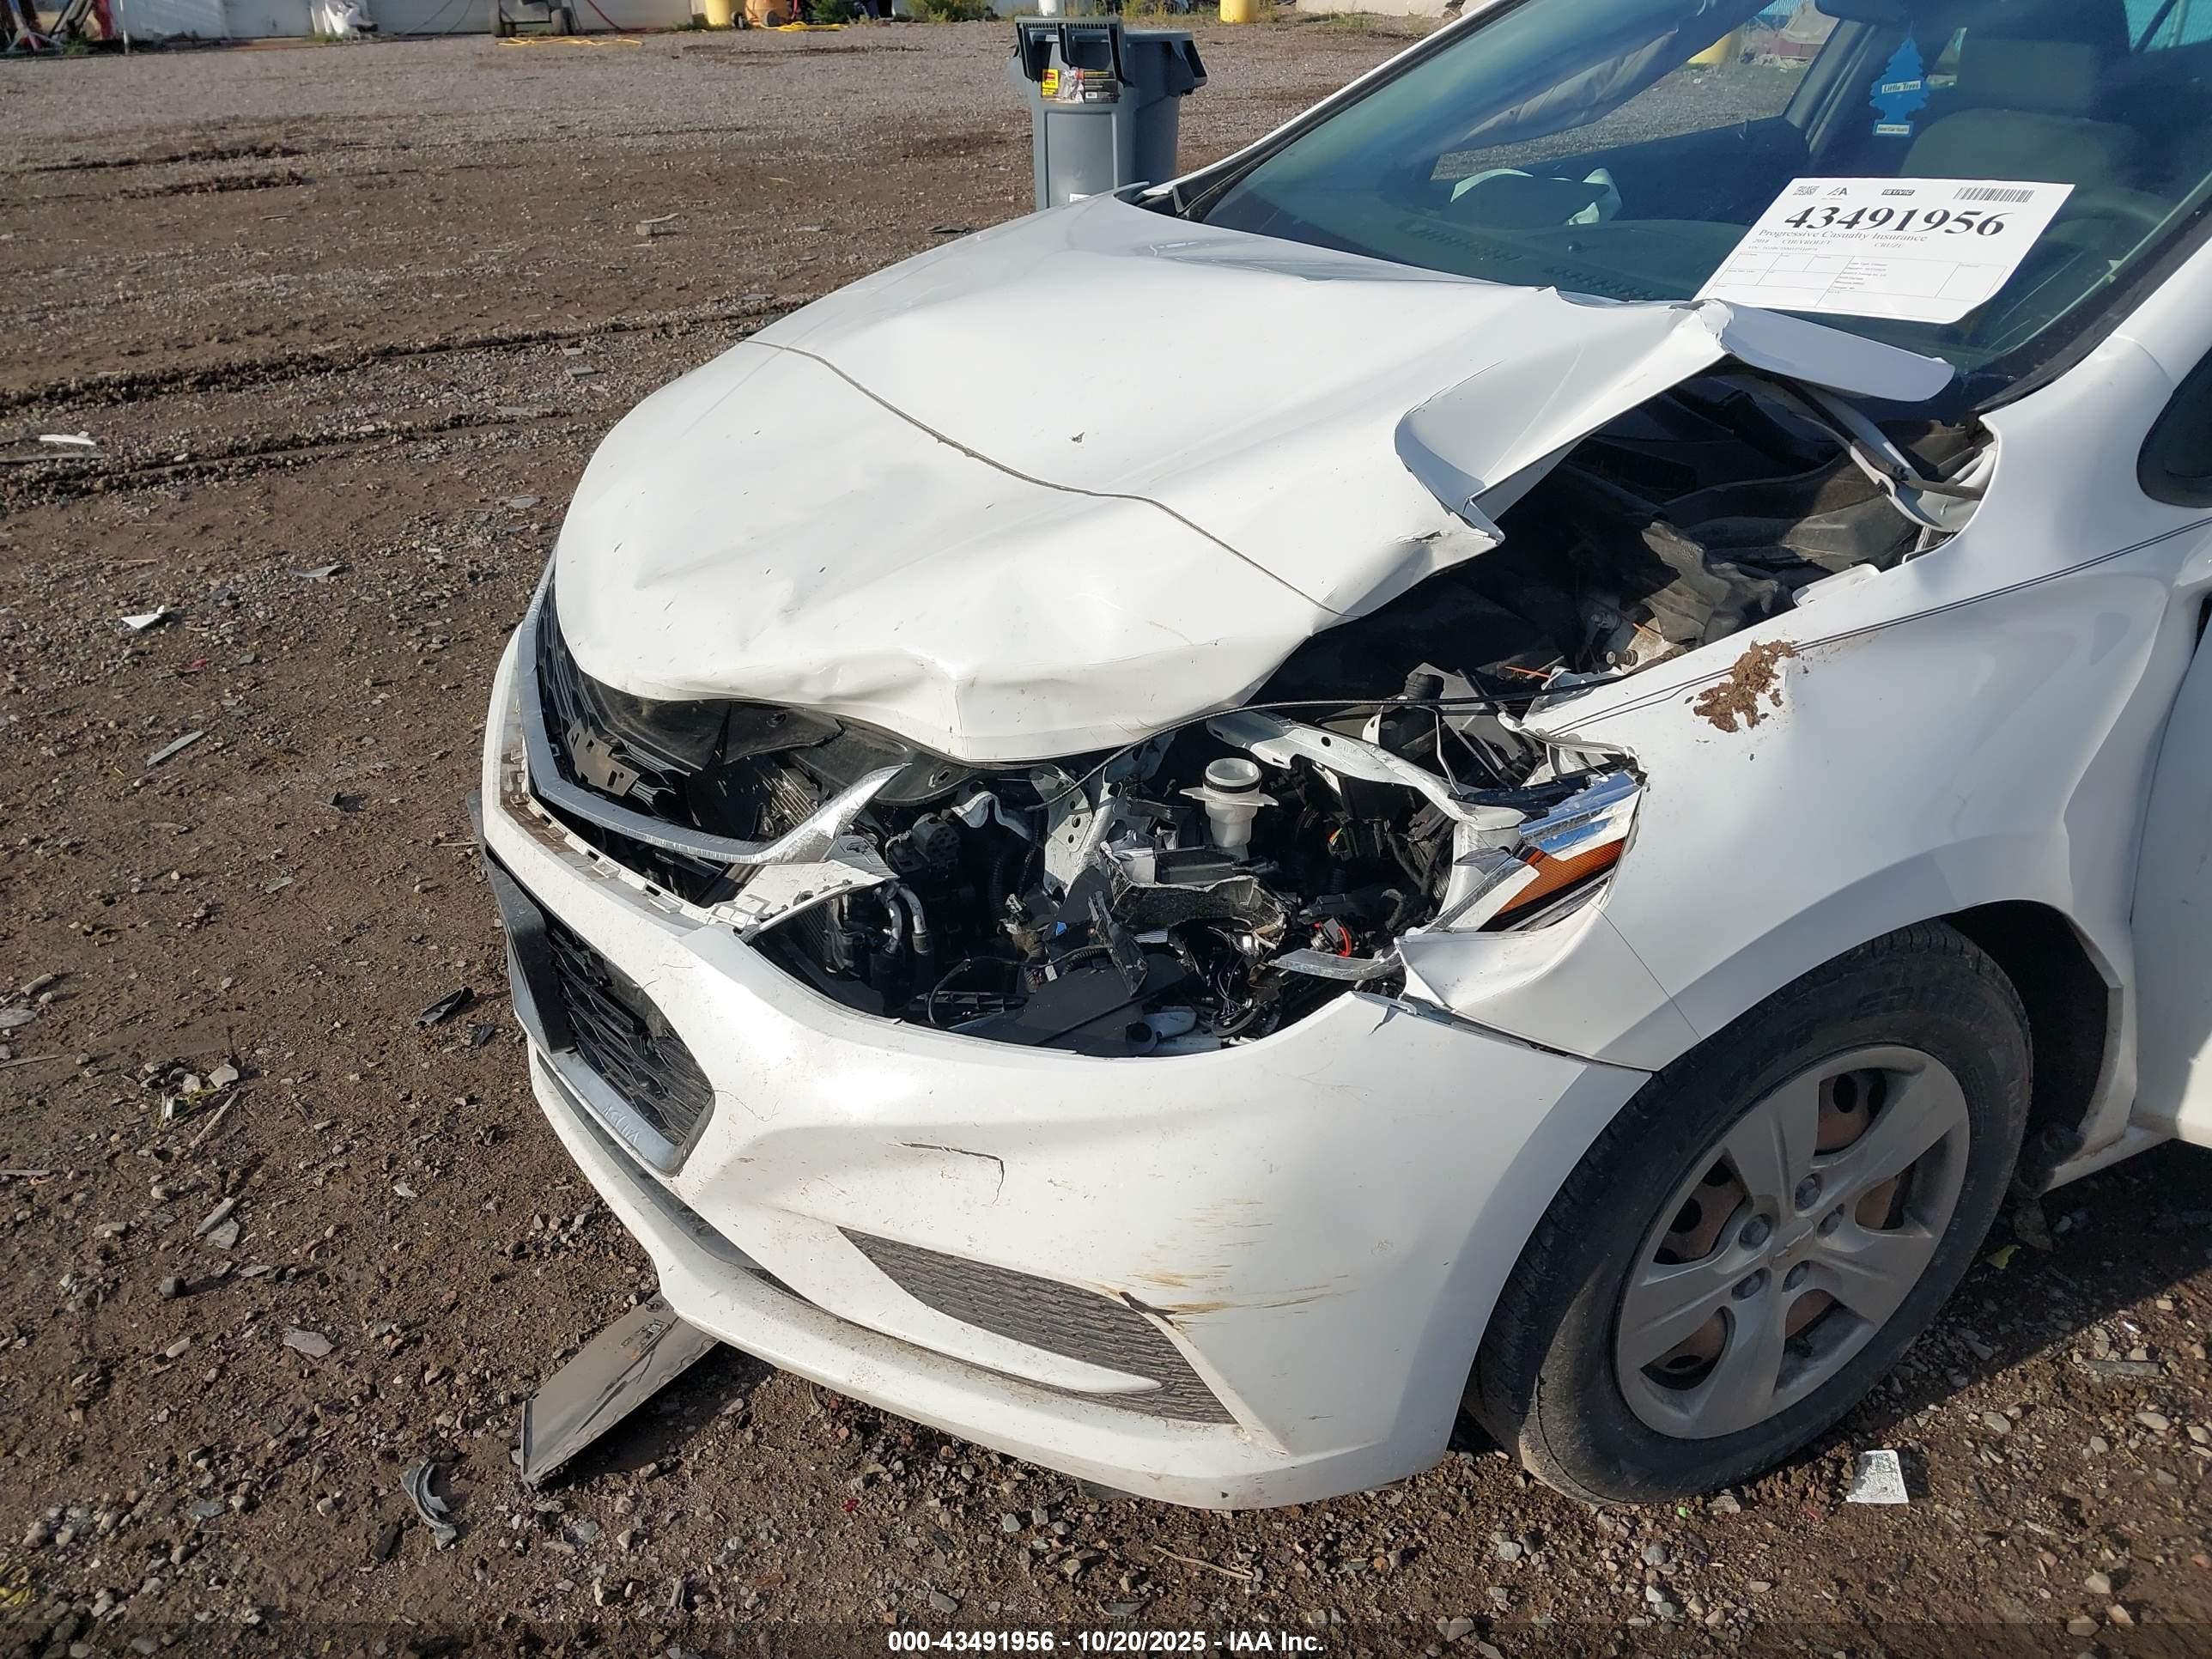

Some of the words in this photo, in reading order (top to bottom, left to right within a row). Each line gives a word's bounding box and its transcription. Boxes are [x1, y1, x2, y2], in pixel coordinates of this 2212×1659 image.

[1784, 206, 2014, 236] 43491956
[1759, 228, 1820, 238] Progressive
[1821, 230, 1870, 240] Casualty
[1872, 233, 1929, 241] Insurance
